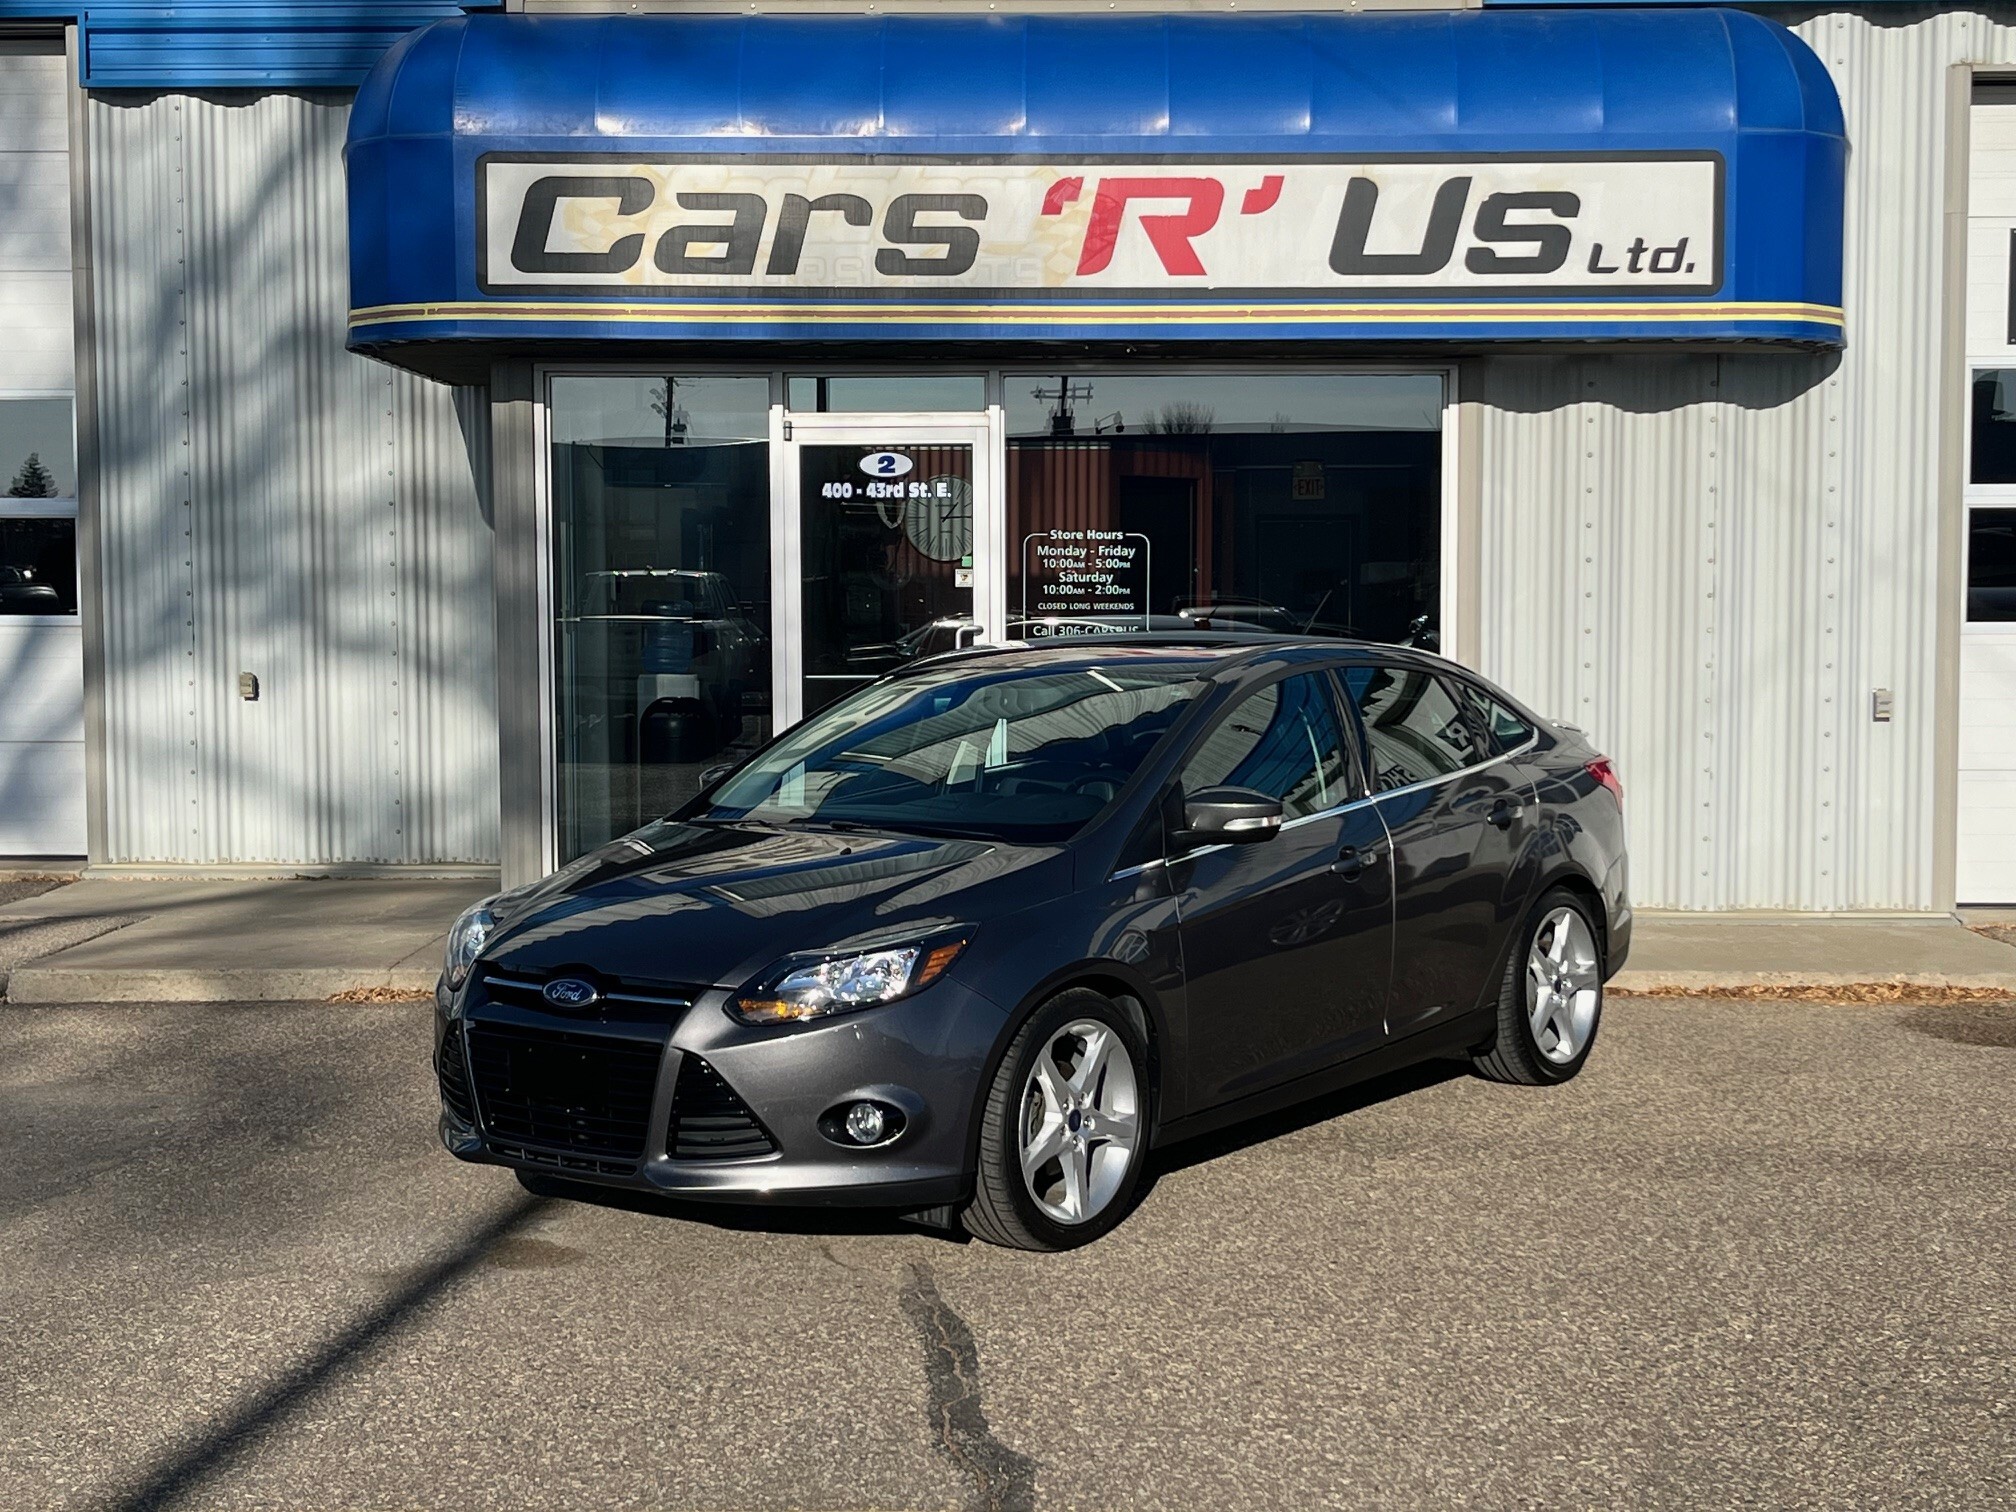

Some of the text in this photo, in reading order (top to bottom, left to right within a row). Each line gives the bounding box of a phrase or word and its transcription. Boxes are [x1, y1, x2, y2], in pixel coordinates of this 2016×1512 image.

[510, 176, 988, 276] Cars
[1328, 176, 1581, 276] Us
[1587, 236, 1696, 275] Ltd.
[877, 455, 896, 474] 2
[821, 482, 853, 498] 400
[865, 482, 904, 498] 43rd
[908, 482, 932, 498] St.
[936, 482, 952, 498] E.
[1297, 479, 1321, 496] EXIT
[1049, 529, 1124, 540] Store Hours
[1037, 545, 1088, 559] Monday
[1098, 545, 1136, 559] Friday
[1042, 558, 1086, 569] 10:00AM
[1095, 558, 1131, 569] 5:00PM
[1058, 572, 1114, 584] Saturday
[1042, 584, 1086, 595] 10:00AM
[1094, 584, 1131, 595] 2:00PM
[1037, 602, 1135, 610] CLOSED LONG WEEKENDS
[1032, 624, 1055, 637] Call
[551, 982, 582, 1001] Ford
